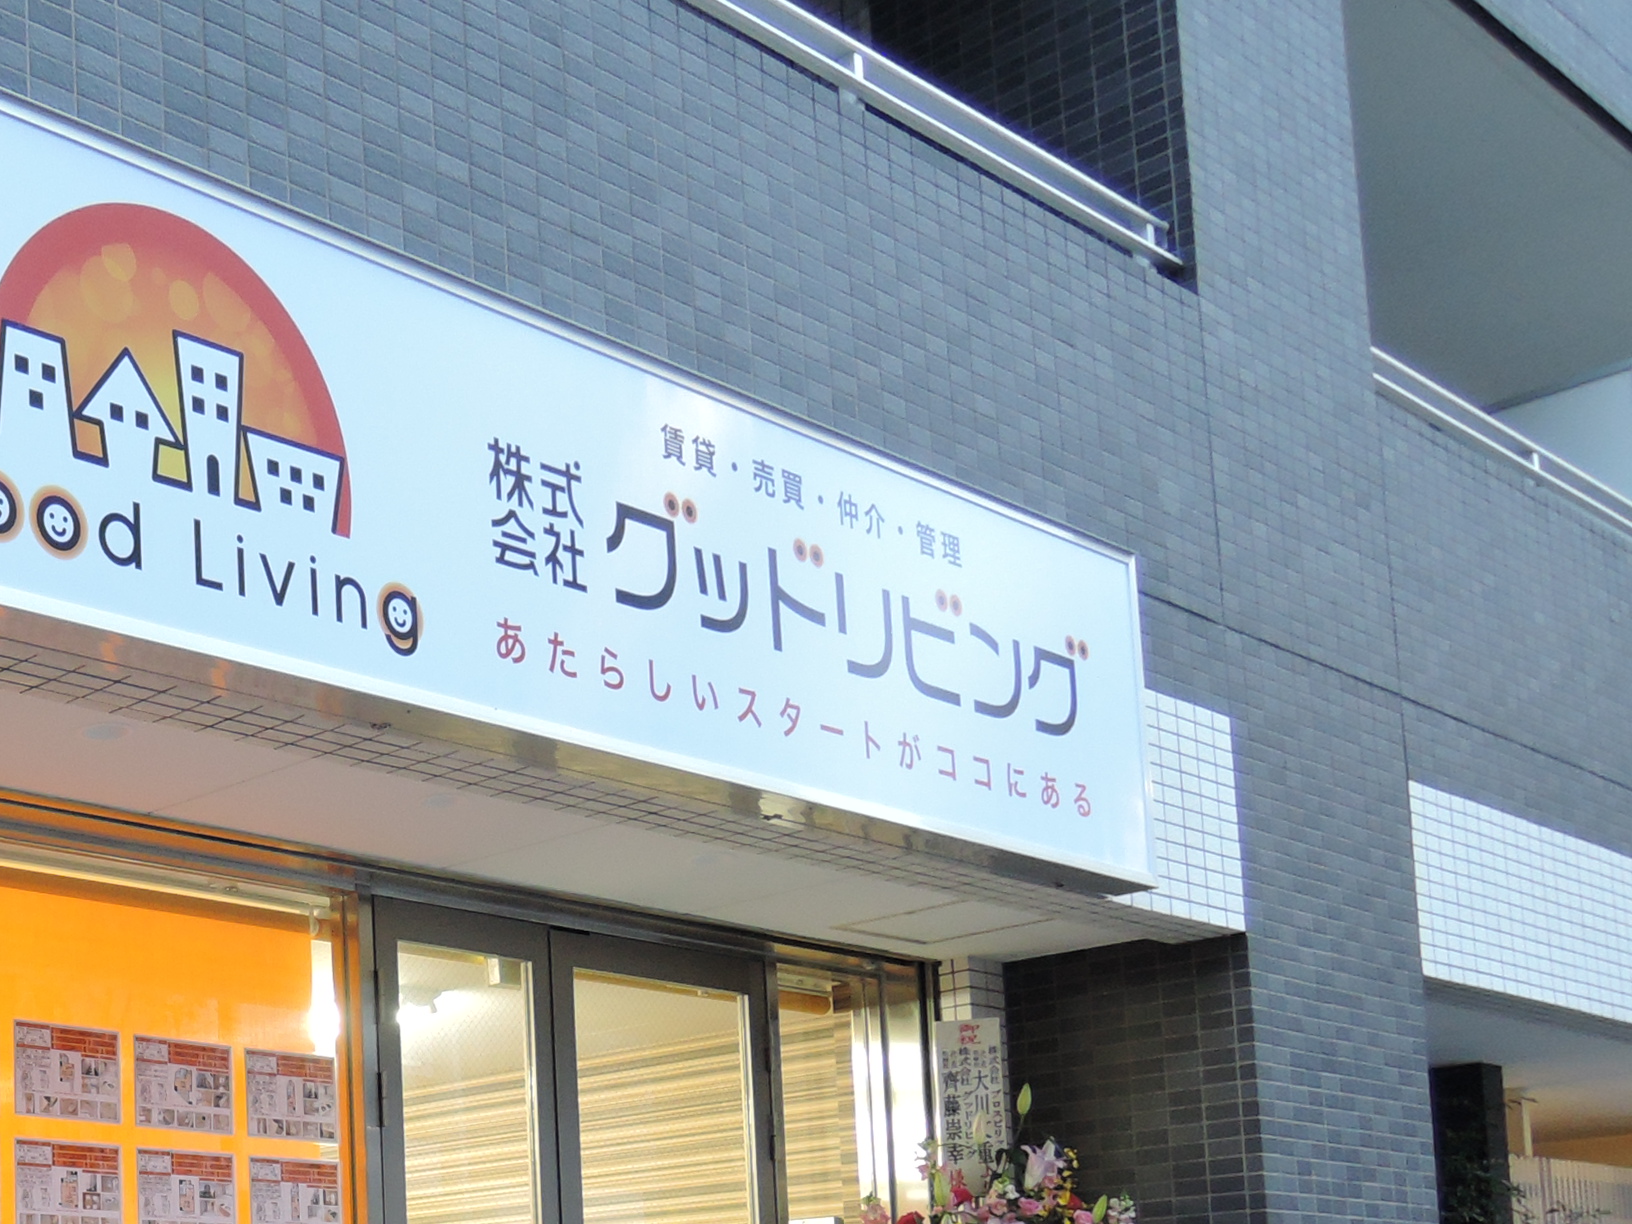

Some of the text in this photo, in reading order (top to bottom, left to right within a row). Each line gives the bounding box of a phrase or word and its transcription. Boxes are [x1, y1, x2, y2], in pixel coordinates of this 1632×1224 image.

[660, 422, 963, 569] 賃貸・売買・仲介・管理
[193, 518, 421, 657] Living
[606, 491, 1090, 737] グッドリビング
[495, 617, 1093, 818] あたらしいスタートがココにある
